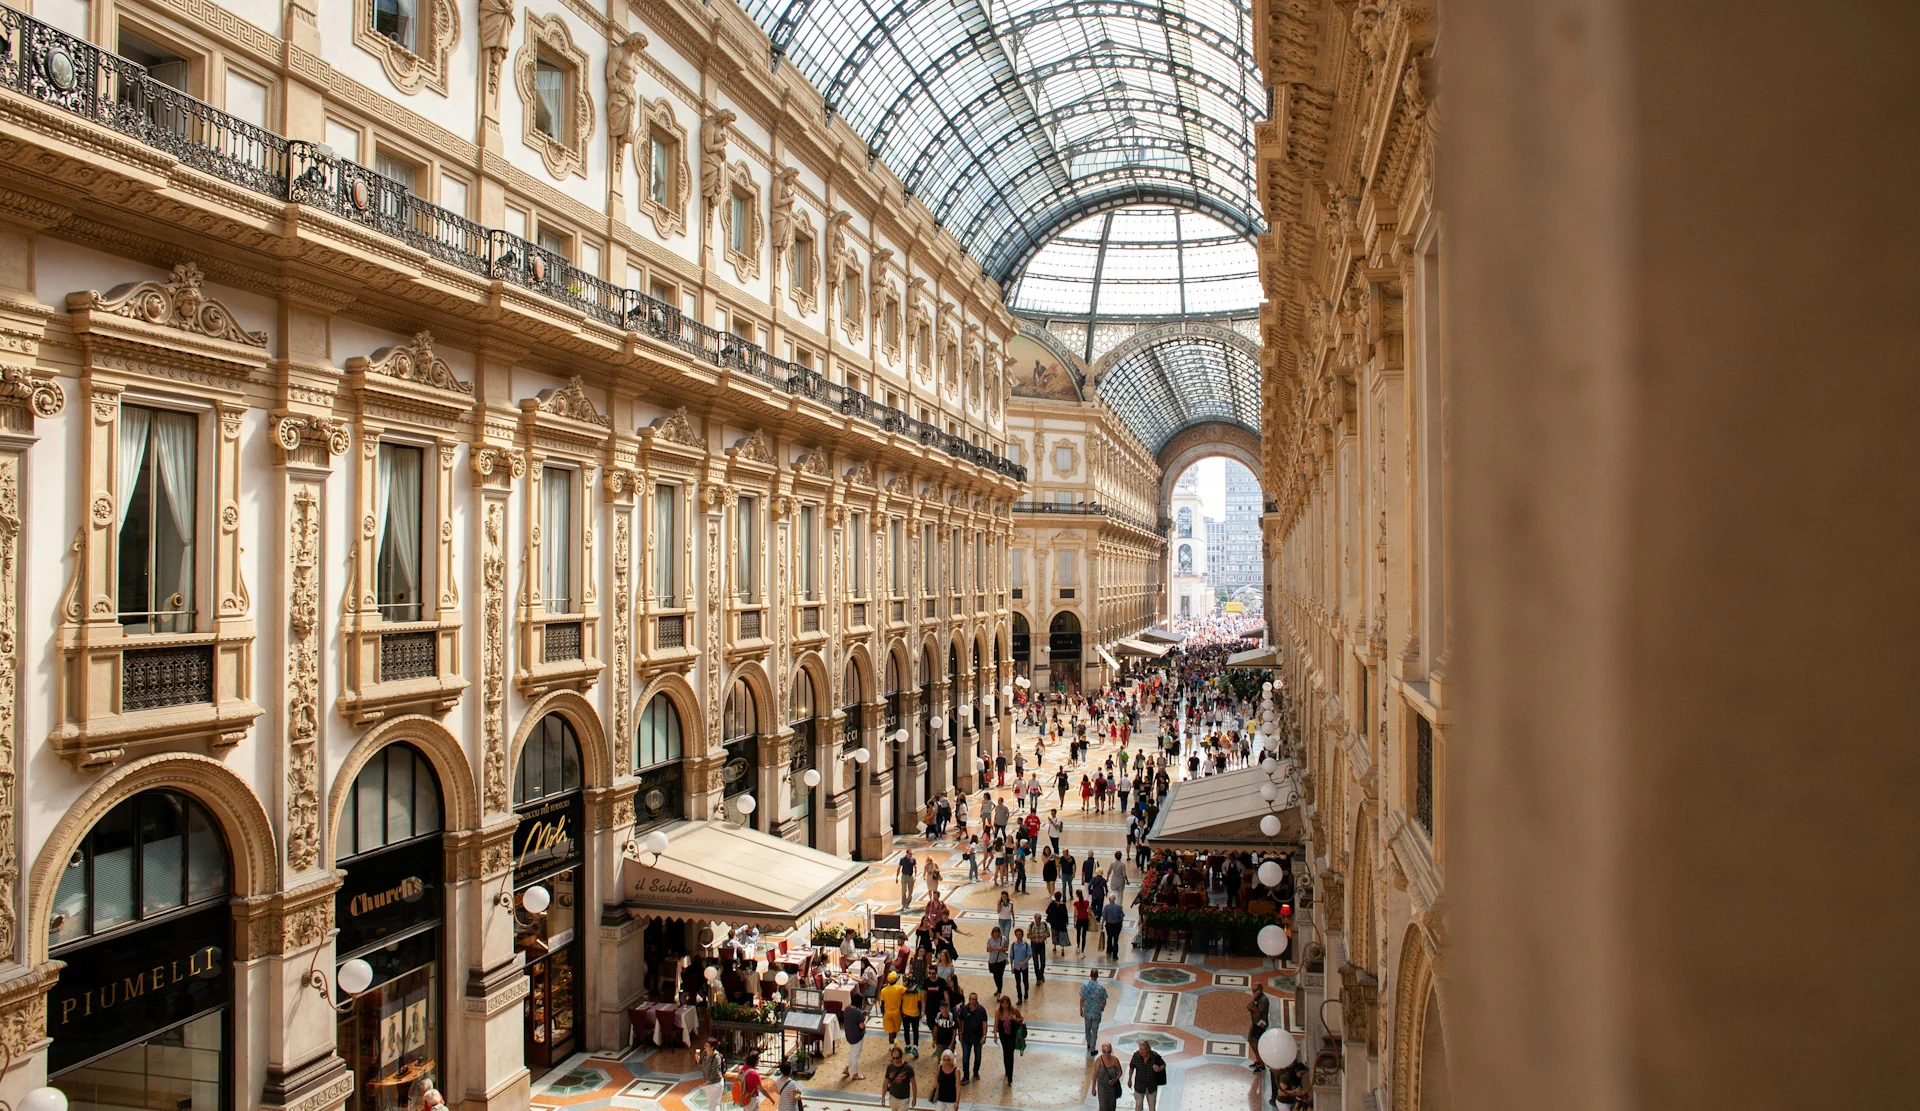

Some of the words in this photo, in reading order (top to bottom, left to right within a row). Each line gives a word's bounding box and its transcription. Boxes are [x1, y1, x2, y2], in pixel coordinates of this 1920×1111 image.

[350, 875, 423, 917] Church's
[635, 877, 644, 890] il
[648, 878, 693, 894] Salotto
[635, 893, 671, 901] RISTORANTE
[675, 896, 693, 904] PIZZA
[60, 947, 214, 1025] PIUMELLI
